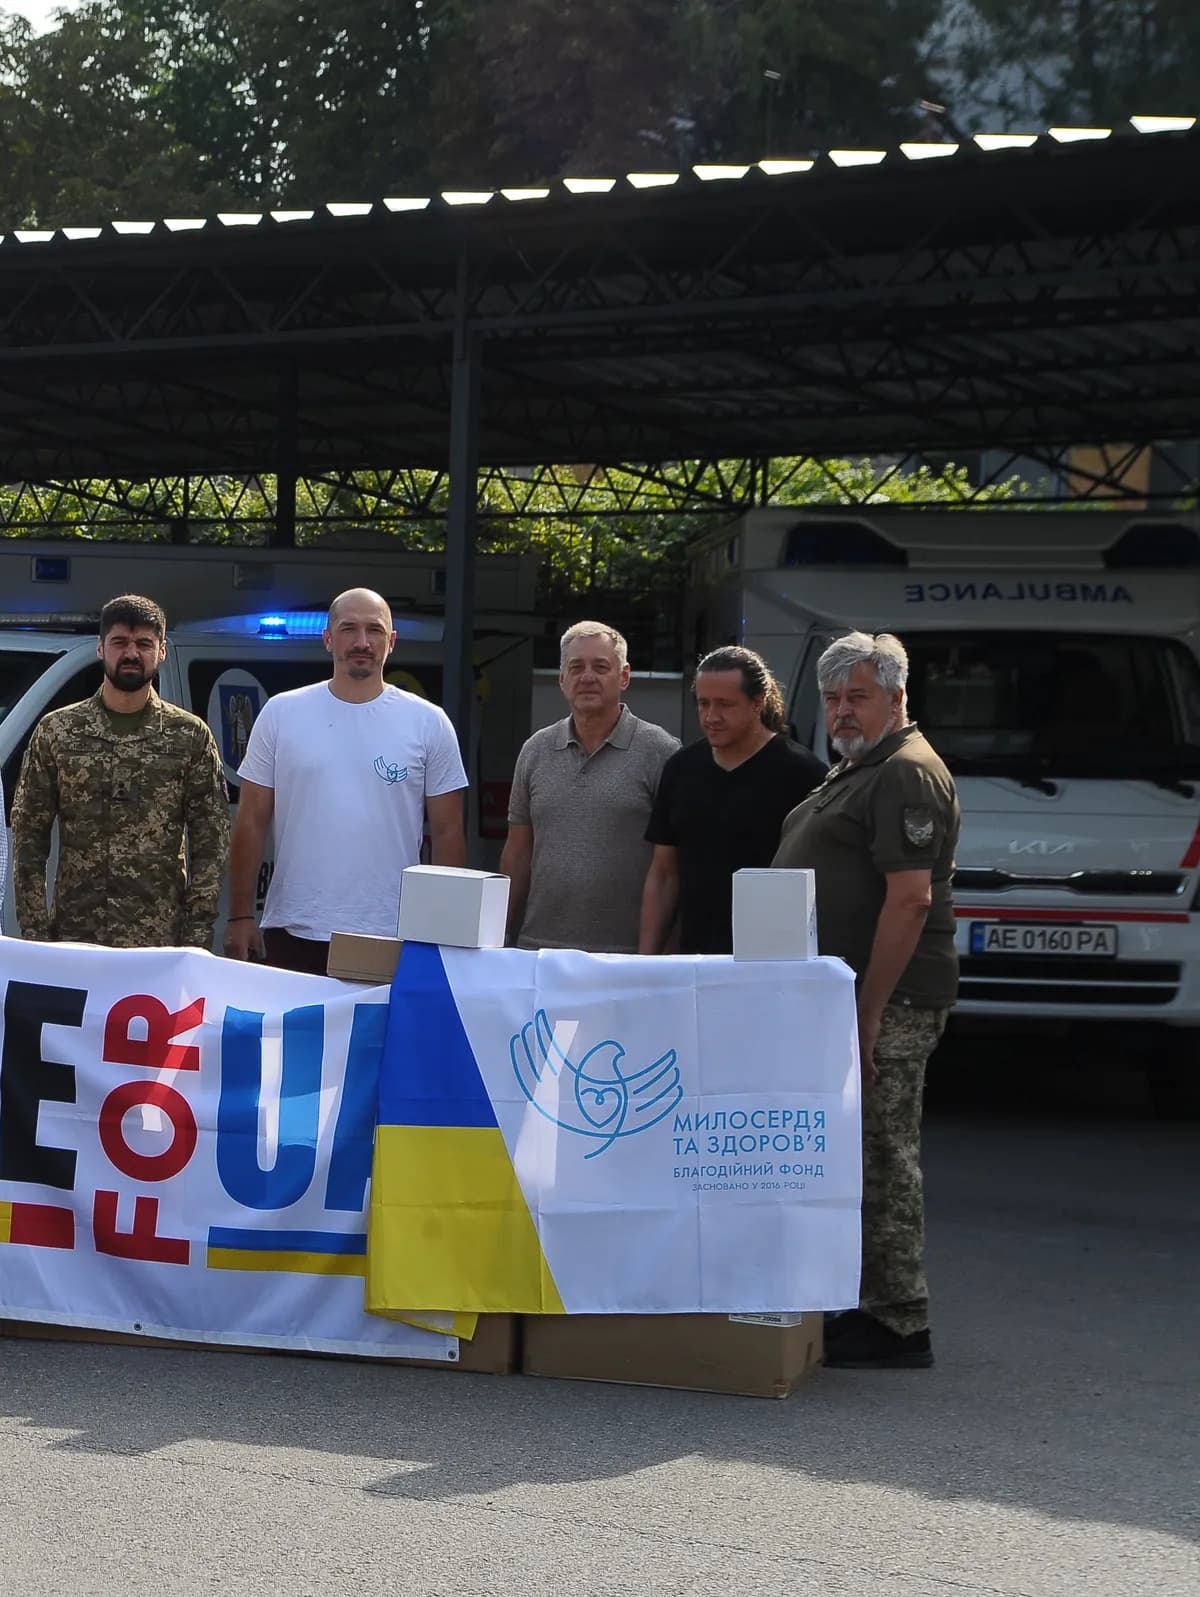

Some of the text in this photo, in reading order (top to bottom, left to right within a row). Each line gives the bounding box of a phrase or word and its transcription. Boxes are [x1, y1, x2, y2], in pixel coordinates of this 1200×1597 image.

[987, 928, 1109, 951] AE 0160 PA
[92, 993, 206, 1266] FOR
[672, 1110, 826, 1133] МИЛОСЕРДЯ
[672, 1134, 826, 1157] ТА ЗДОРОВ'Я
[673, 1161, 825, 1179] БЛАГОДІЙНИЙ ФОНД
[691, 1183, 749, 1192] ЗАСНОВАНО
[761, 1181, 781, 1190] 2016
